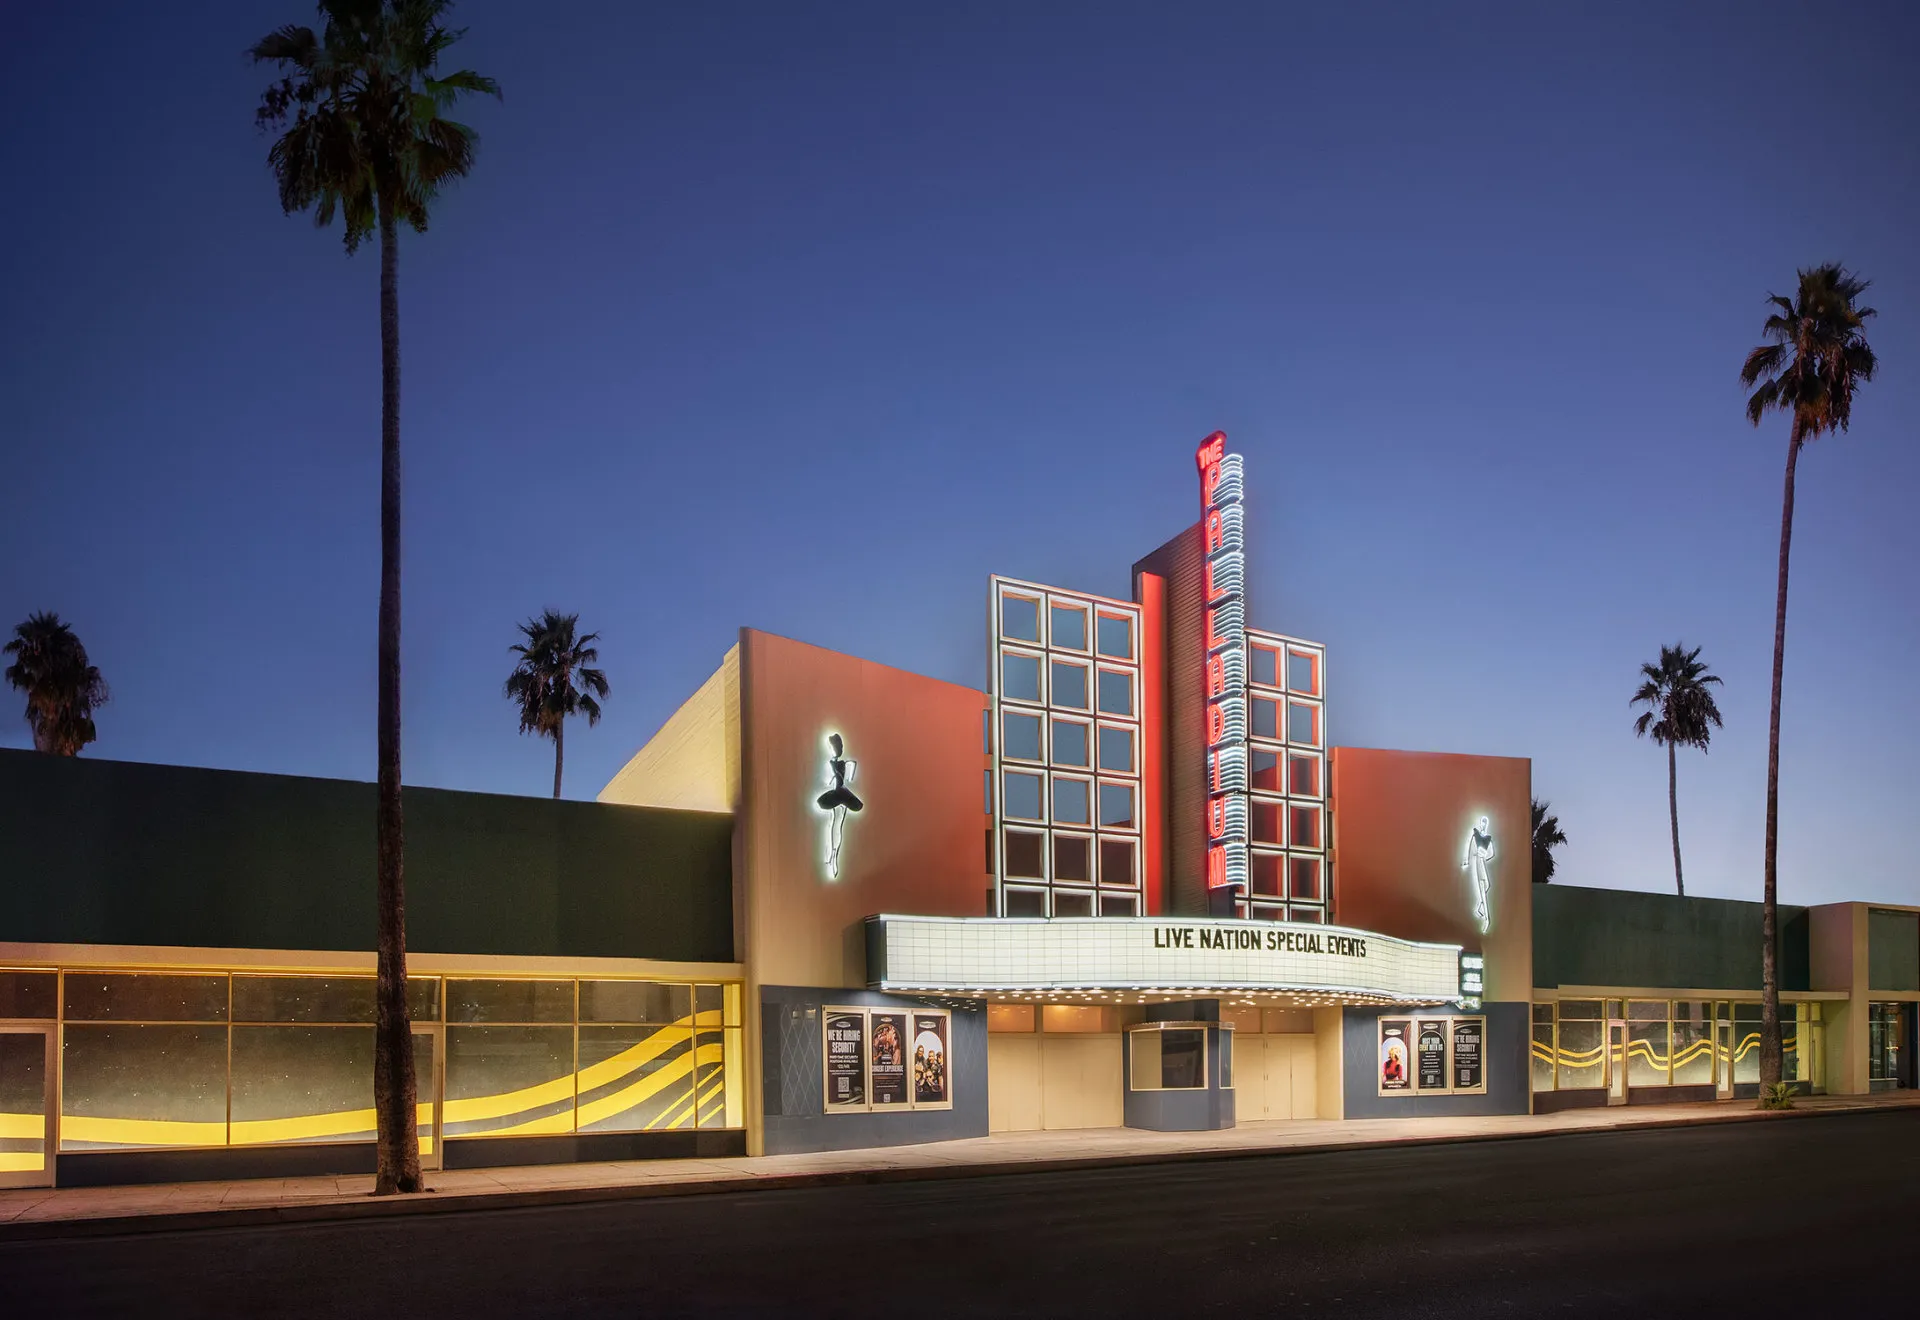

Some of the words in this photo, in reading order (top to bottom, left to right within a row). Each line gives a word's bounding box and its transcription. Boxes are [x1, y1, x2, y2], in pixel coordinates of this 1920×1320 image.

[1199, 438, 1222, 469] THE
[1205, 461, 1227, 888] PALLADIUM
[1154, 928, 1194, 948] LIVE
[1200, 929, 1262, 950] NATION
[1267, 931, 1324, 953] SPECIAL
[1327, 935, 1366, 957] EVENTS
